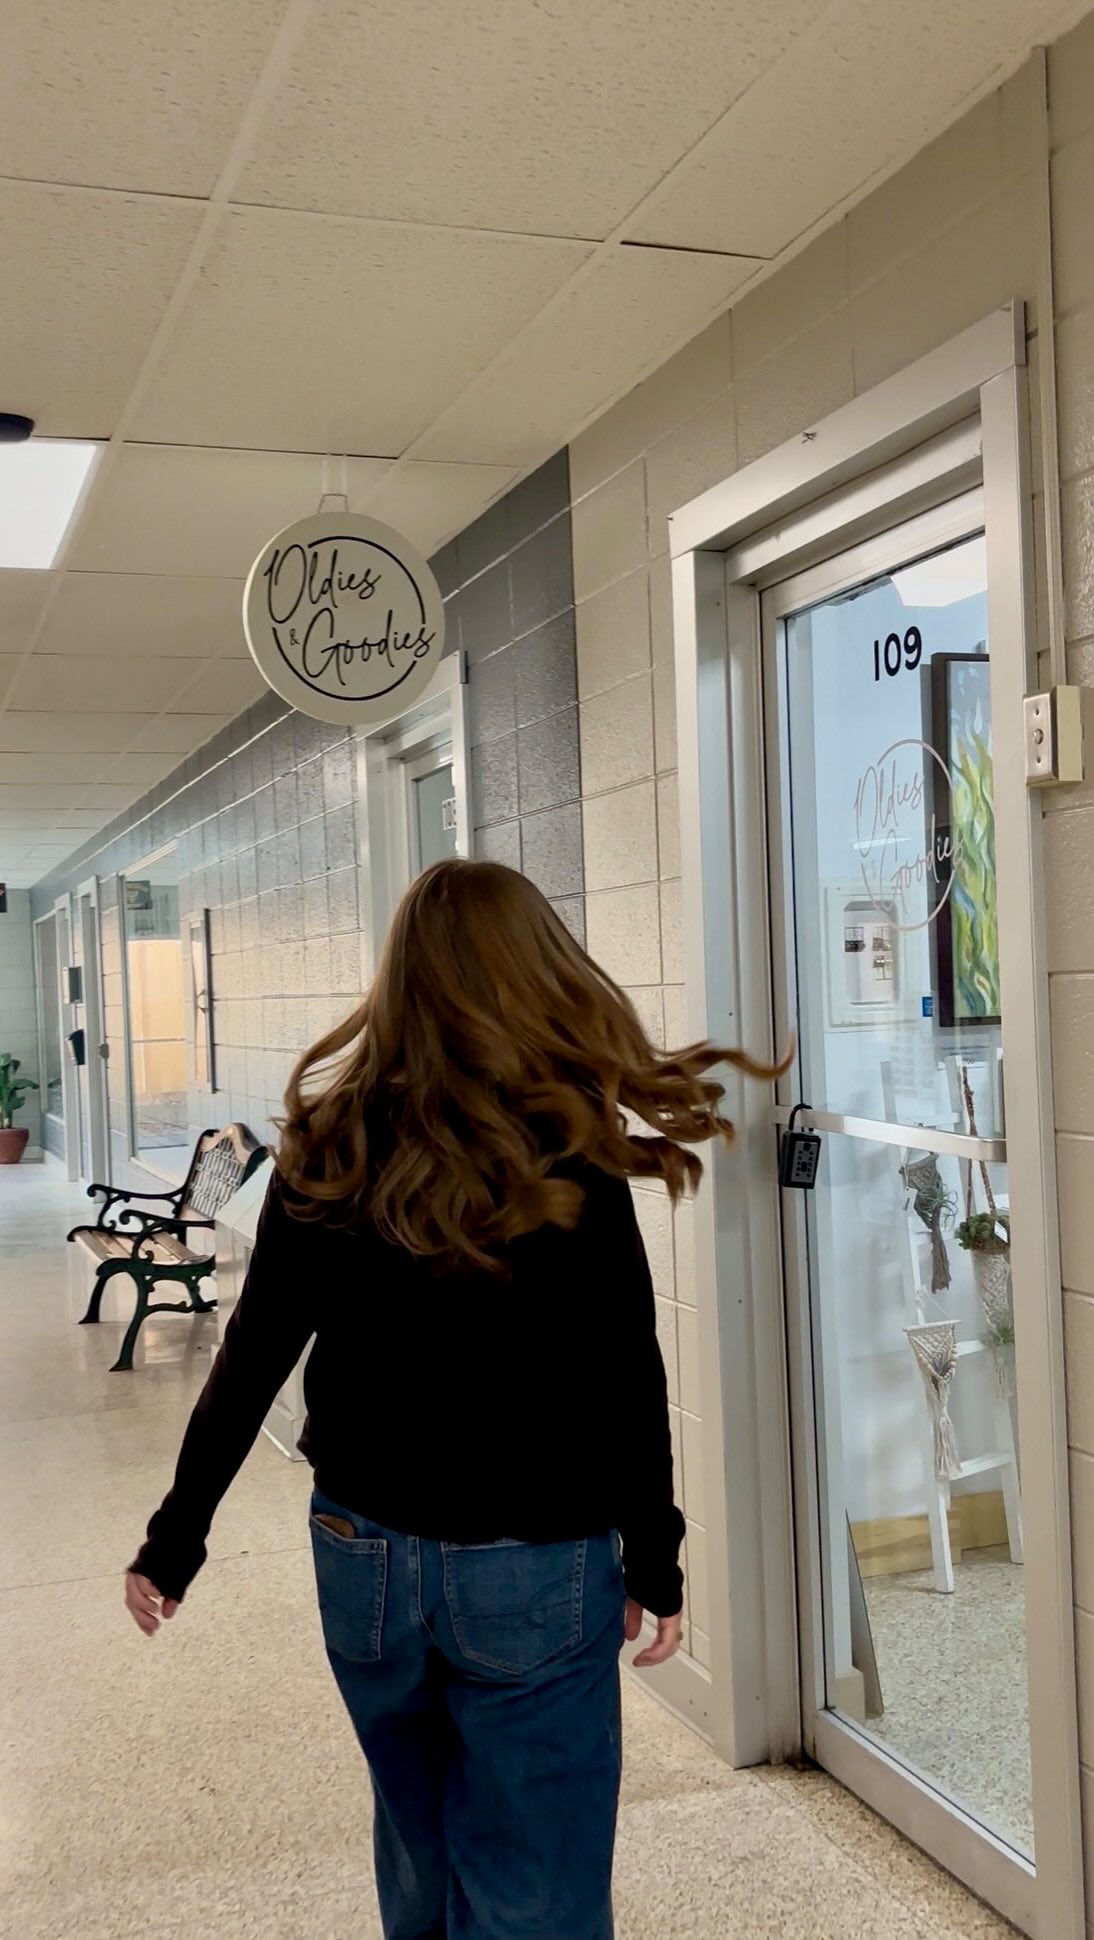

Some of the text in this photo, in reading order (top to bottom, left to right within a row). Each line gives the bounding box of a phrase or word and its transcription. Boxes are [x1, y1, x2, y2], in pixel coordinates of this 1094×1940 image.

[263, 543, 382, 624] Oldies
[289, 607, 436, 686] & Goodies
[873, 625, 922, 682] 109
[853, 759, 925, 858] Oldies
